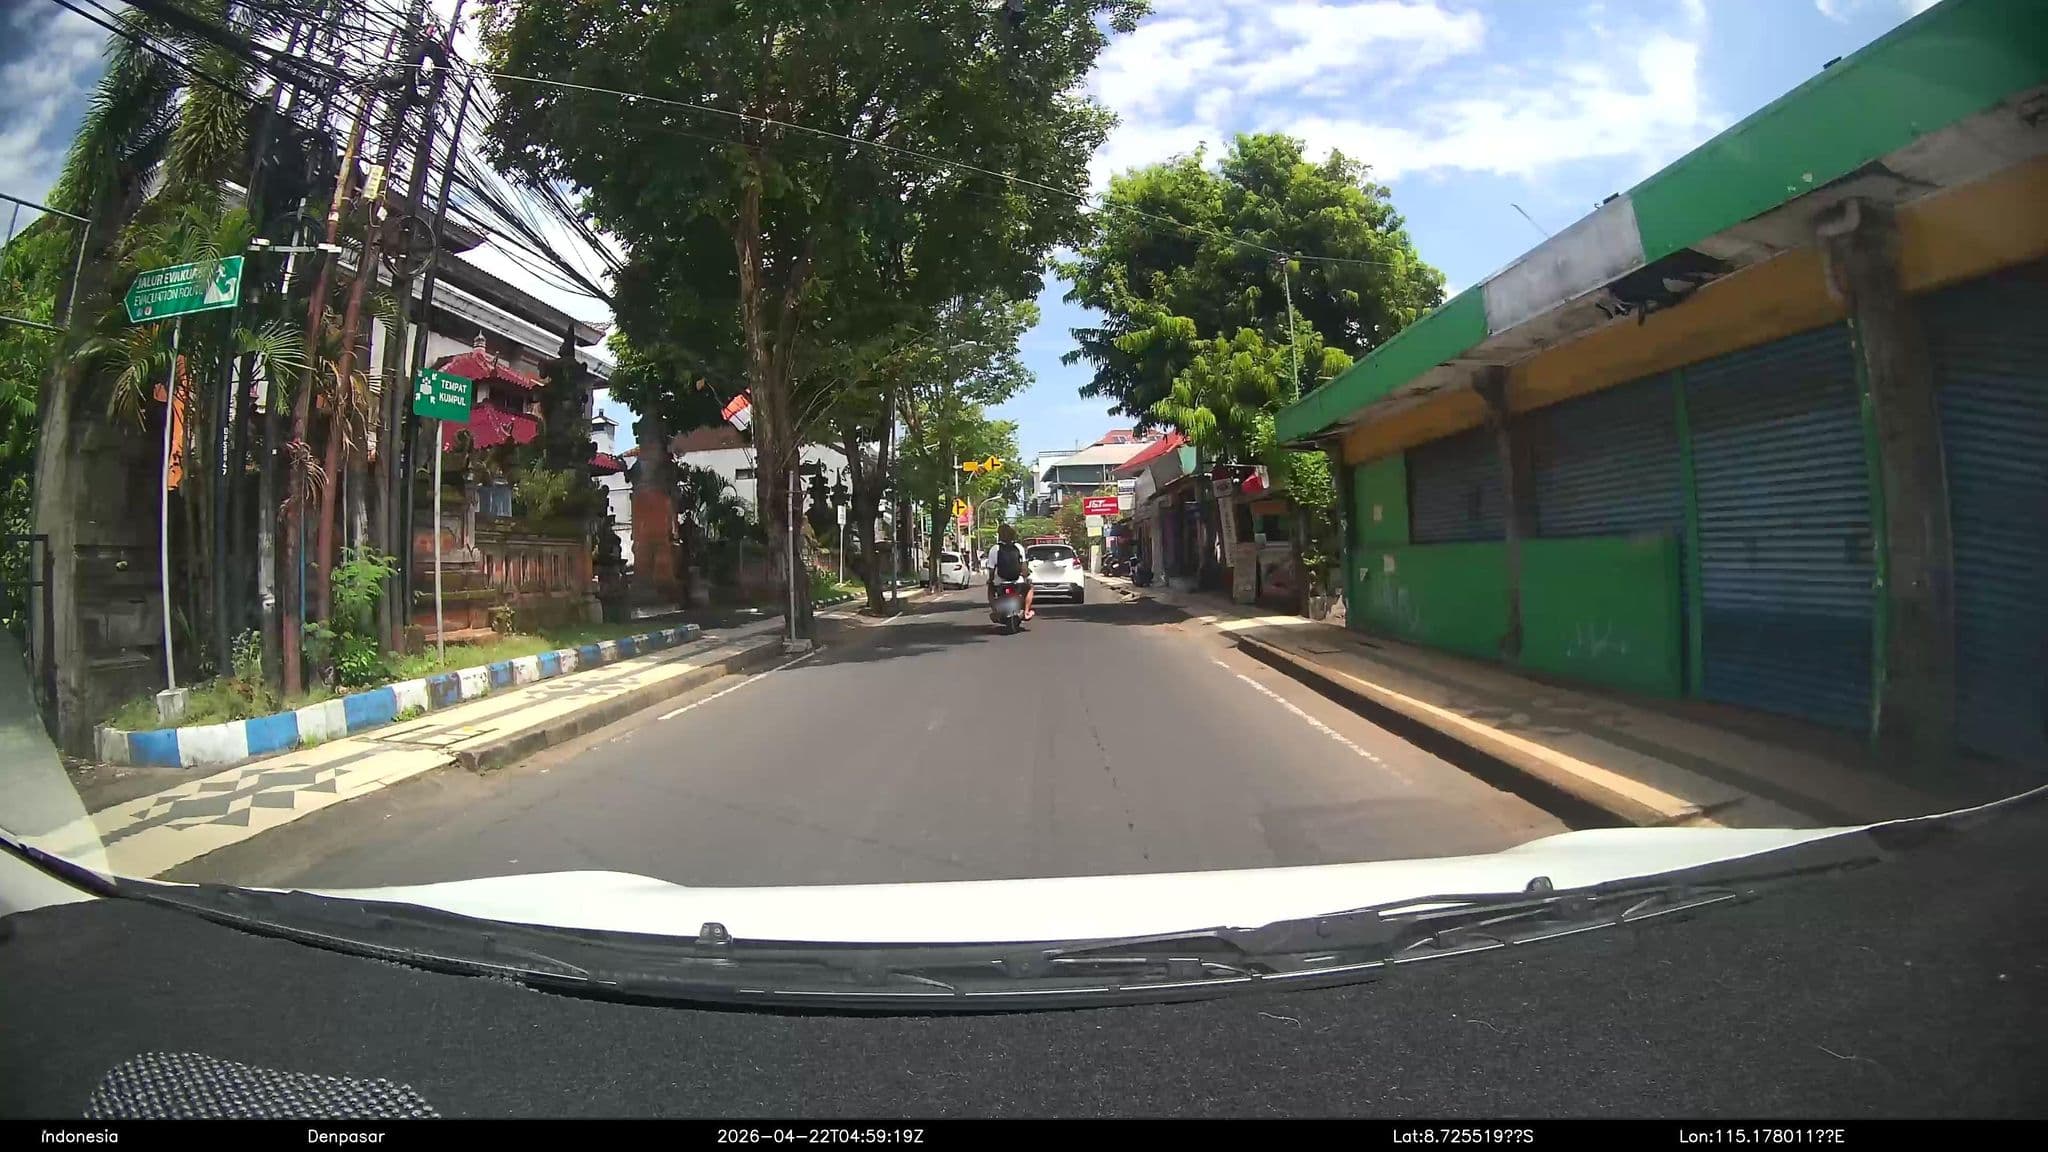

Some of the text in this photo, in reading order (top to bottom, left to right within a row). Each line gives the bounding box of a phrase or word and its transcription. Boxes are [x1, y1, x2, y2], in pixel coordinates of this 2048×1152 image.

[137, 268, 207, 289] JALUR EVAKUA
[134, 289, 178, 306] EVACUATION
[441, 380, 467, 393] TEMPAT
[439, 392, 466, 406] KUMPUL
